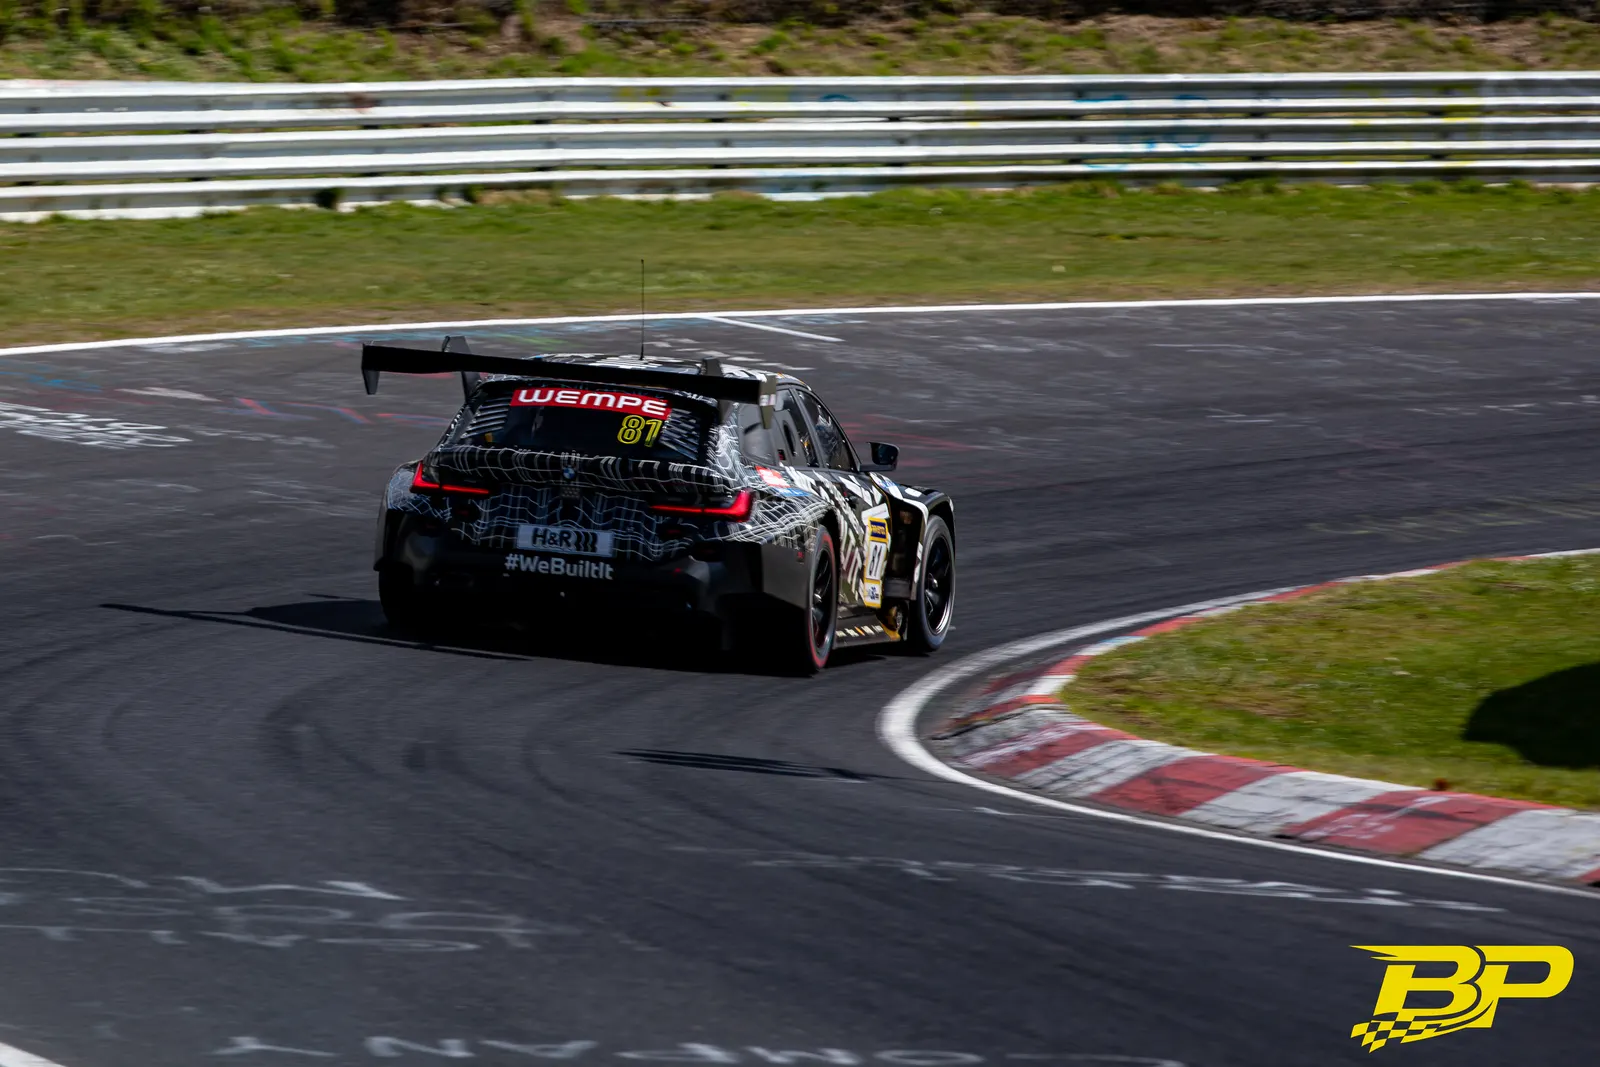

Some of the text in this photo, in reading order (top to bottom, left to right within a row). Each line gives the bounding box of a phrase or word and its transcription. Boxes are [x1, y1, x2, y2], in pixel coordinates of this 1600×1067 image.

[518, 389, 667, 416] WEMPE
[617, 415, 663, 447] 81
[532, 528, 572, 548] H&R
[504, 553, 614, 580] #WeBuiltIt
[869, 544, 883, 578] 81
